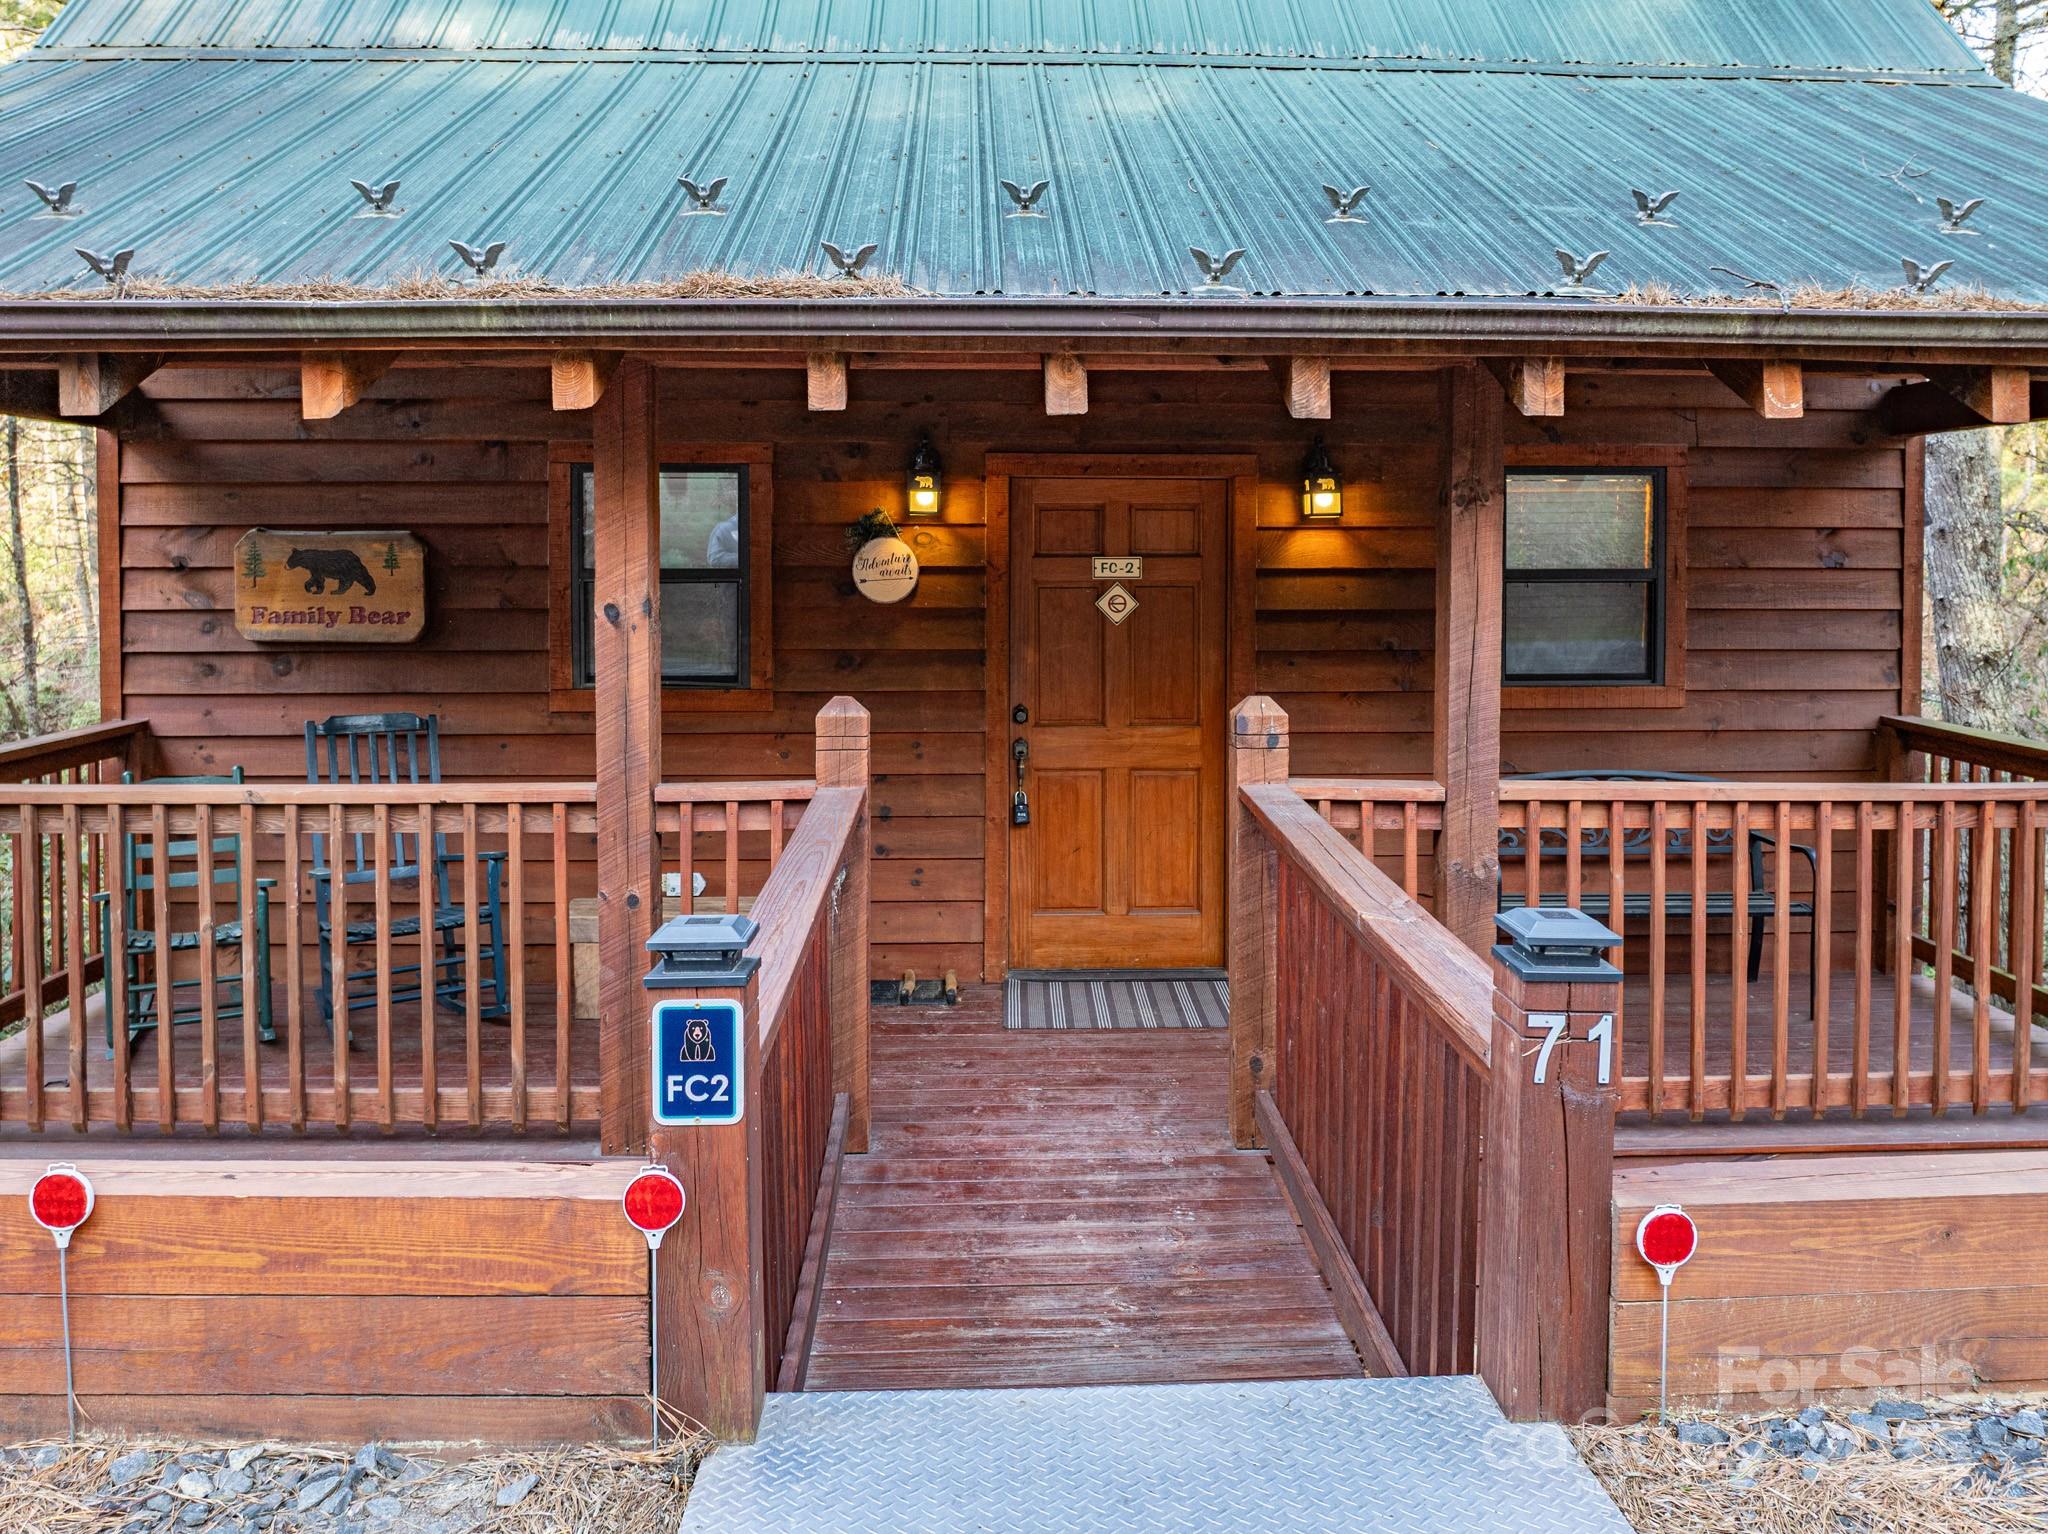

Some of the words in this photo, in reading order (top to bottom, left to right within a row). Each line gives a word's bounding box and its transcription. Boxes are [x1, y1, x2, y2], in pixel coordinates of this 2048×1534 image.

[856, 552, 912, 571] Adventure
[879, 563, 912, 577] awaits
[1100, 562, 1134, 573] FC-2
[251, 606, 343, 629] Family
[348, 606, 412, 625] Bear
[667, 1074, 729, 1102] FC2
